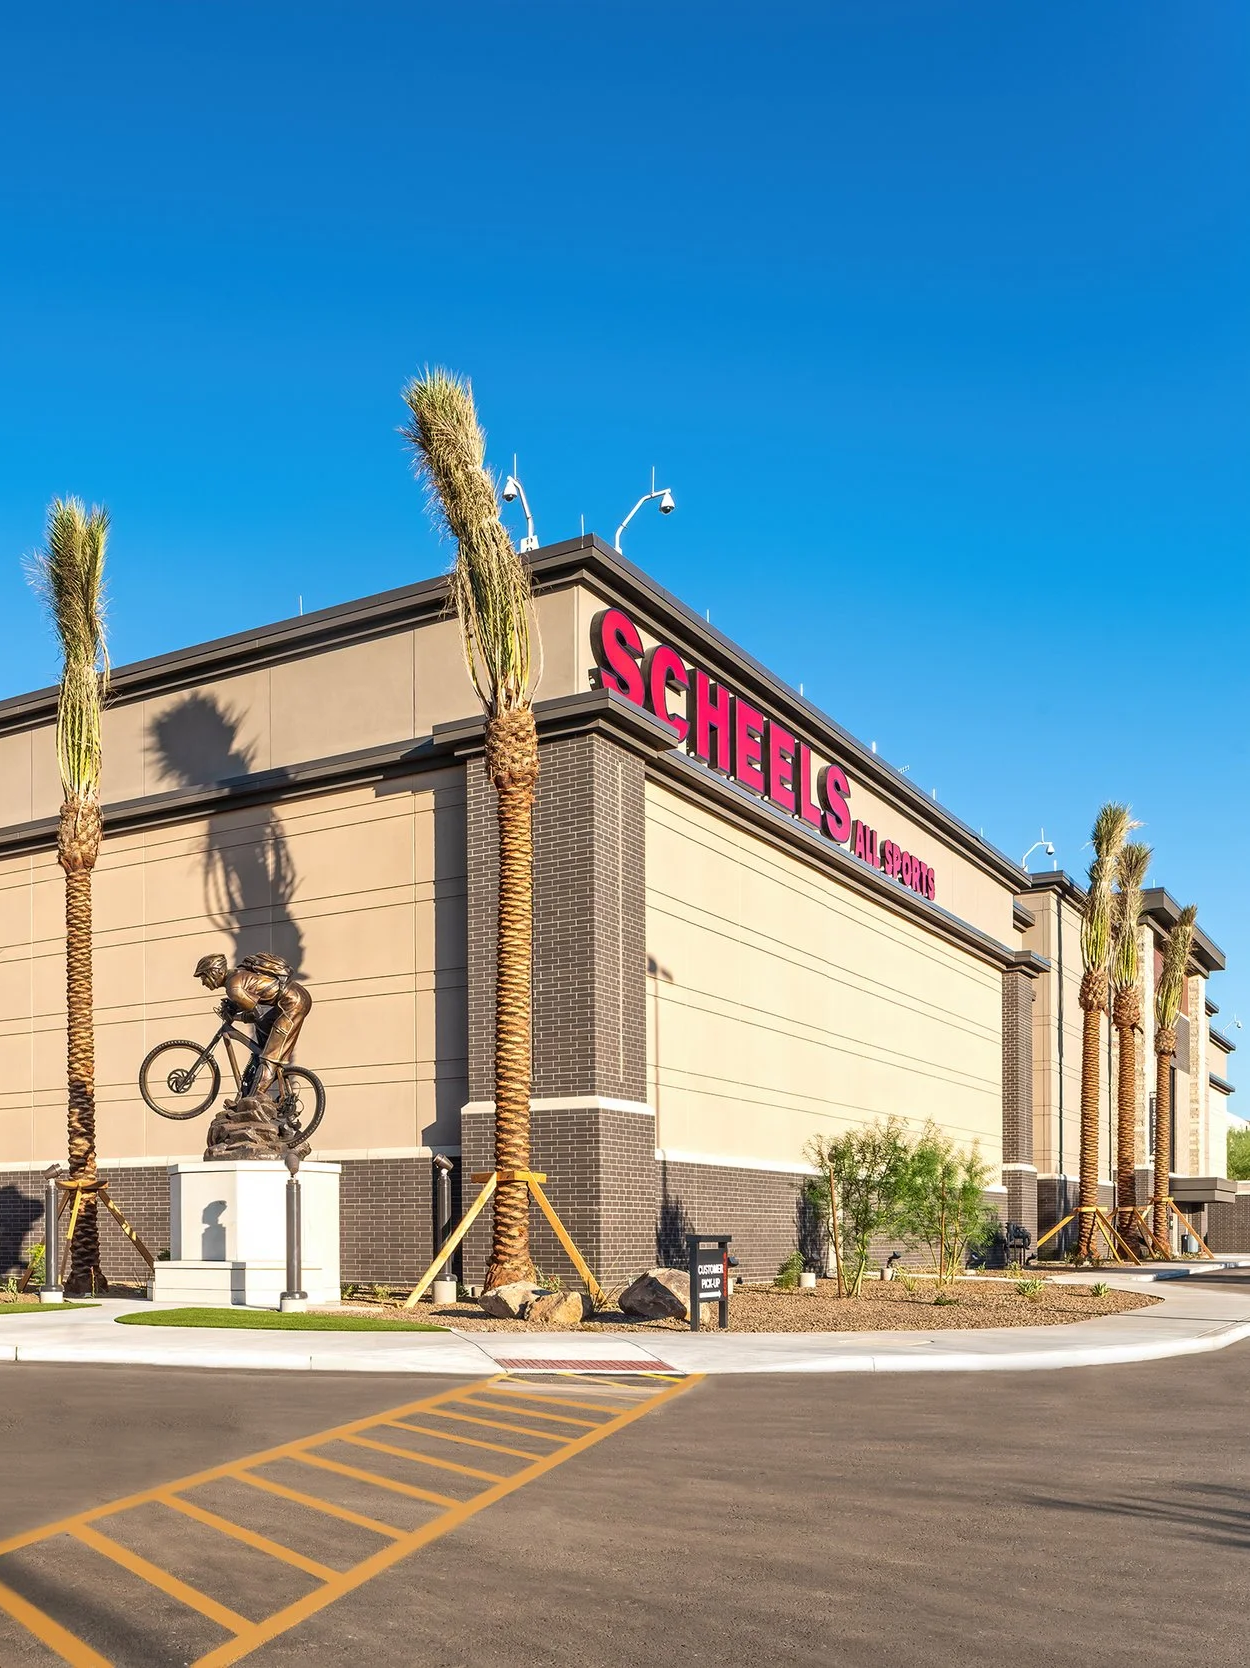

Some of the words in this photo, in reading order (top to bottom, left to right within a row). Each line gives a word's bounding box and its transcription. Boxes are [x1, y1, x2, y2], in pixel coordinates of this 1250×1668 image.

[588, 607, 851, 844] SCHEELS
[850, 819, 881, 870] ALL
[880, 839, 935, 902] SPORTS
[697, 1263, 724, 1275] CUSTOMER
